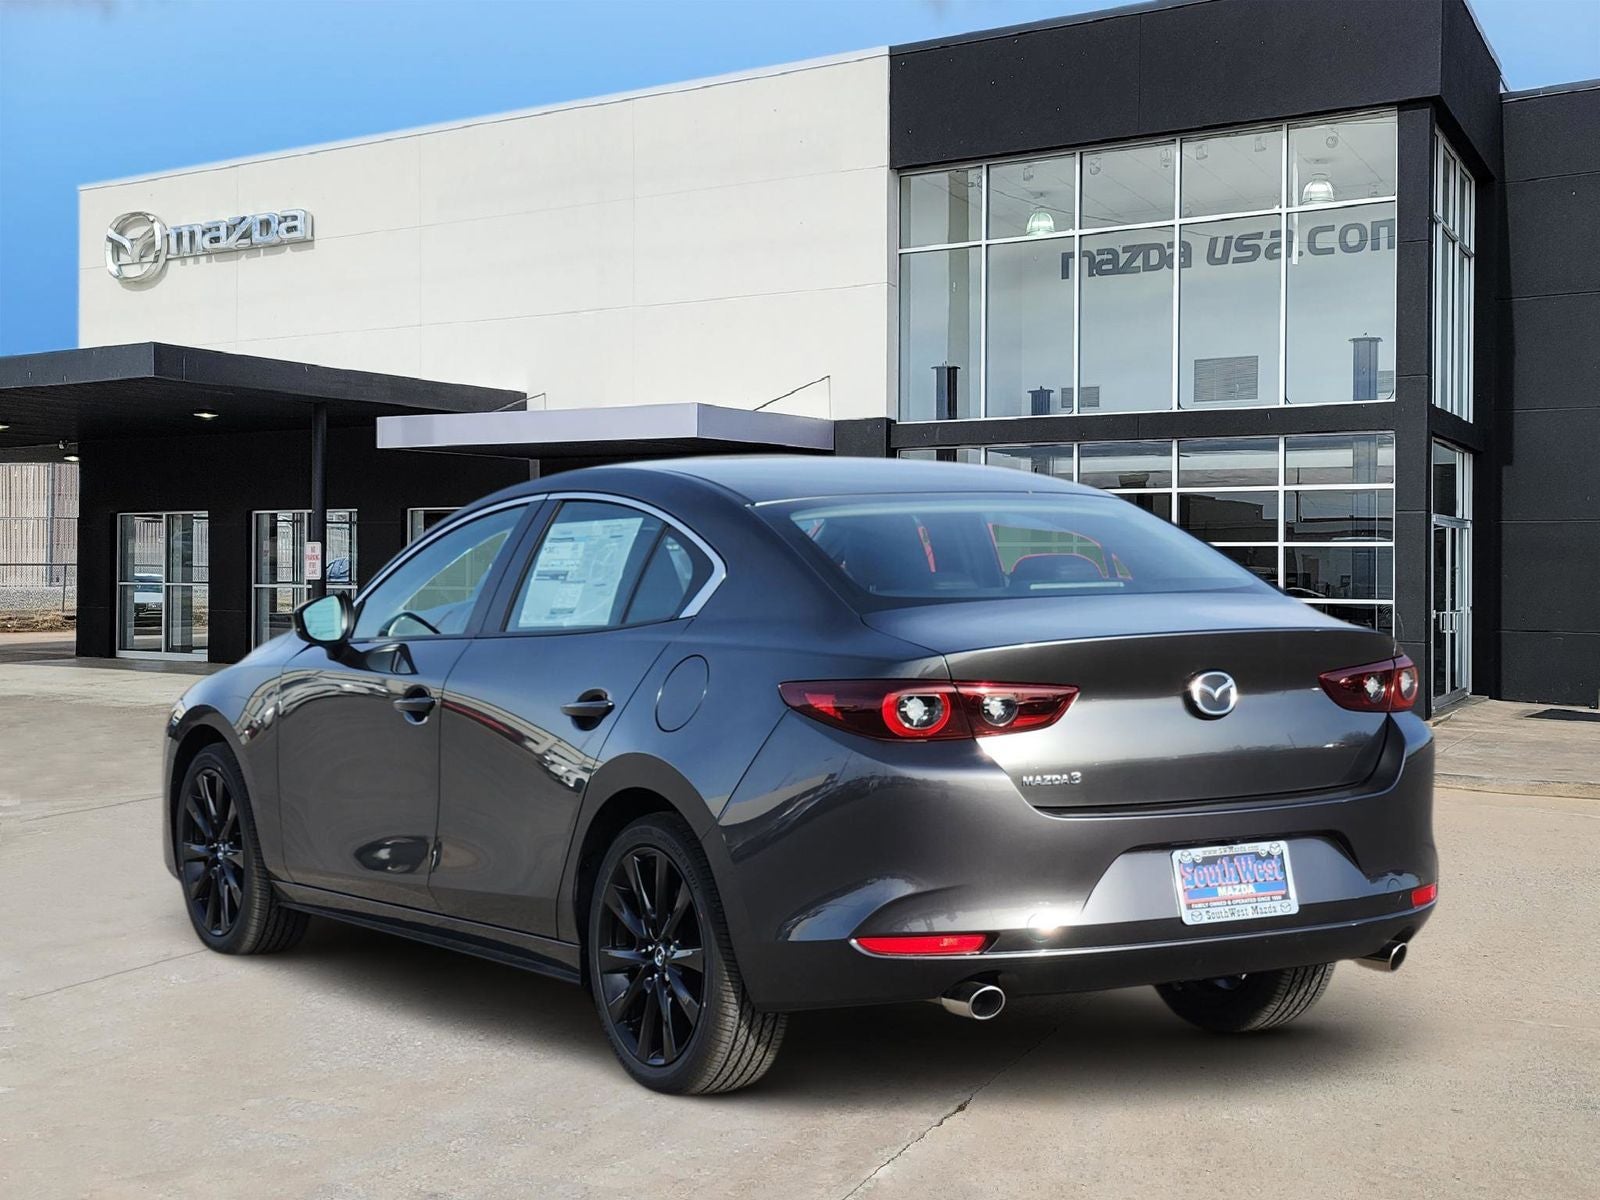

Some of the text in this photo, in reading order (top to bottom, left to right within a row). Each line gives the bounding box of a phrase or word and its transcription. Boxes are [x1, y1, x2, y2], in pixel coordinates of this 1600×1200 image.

[1180, 854, 1284, 888] SouthWest
[1217, 884, 1256, 897] MAZDA
[1206, 904, 1278, 920] SouthWest Mazda
